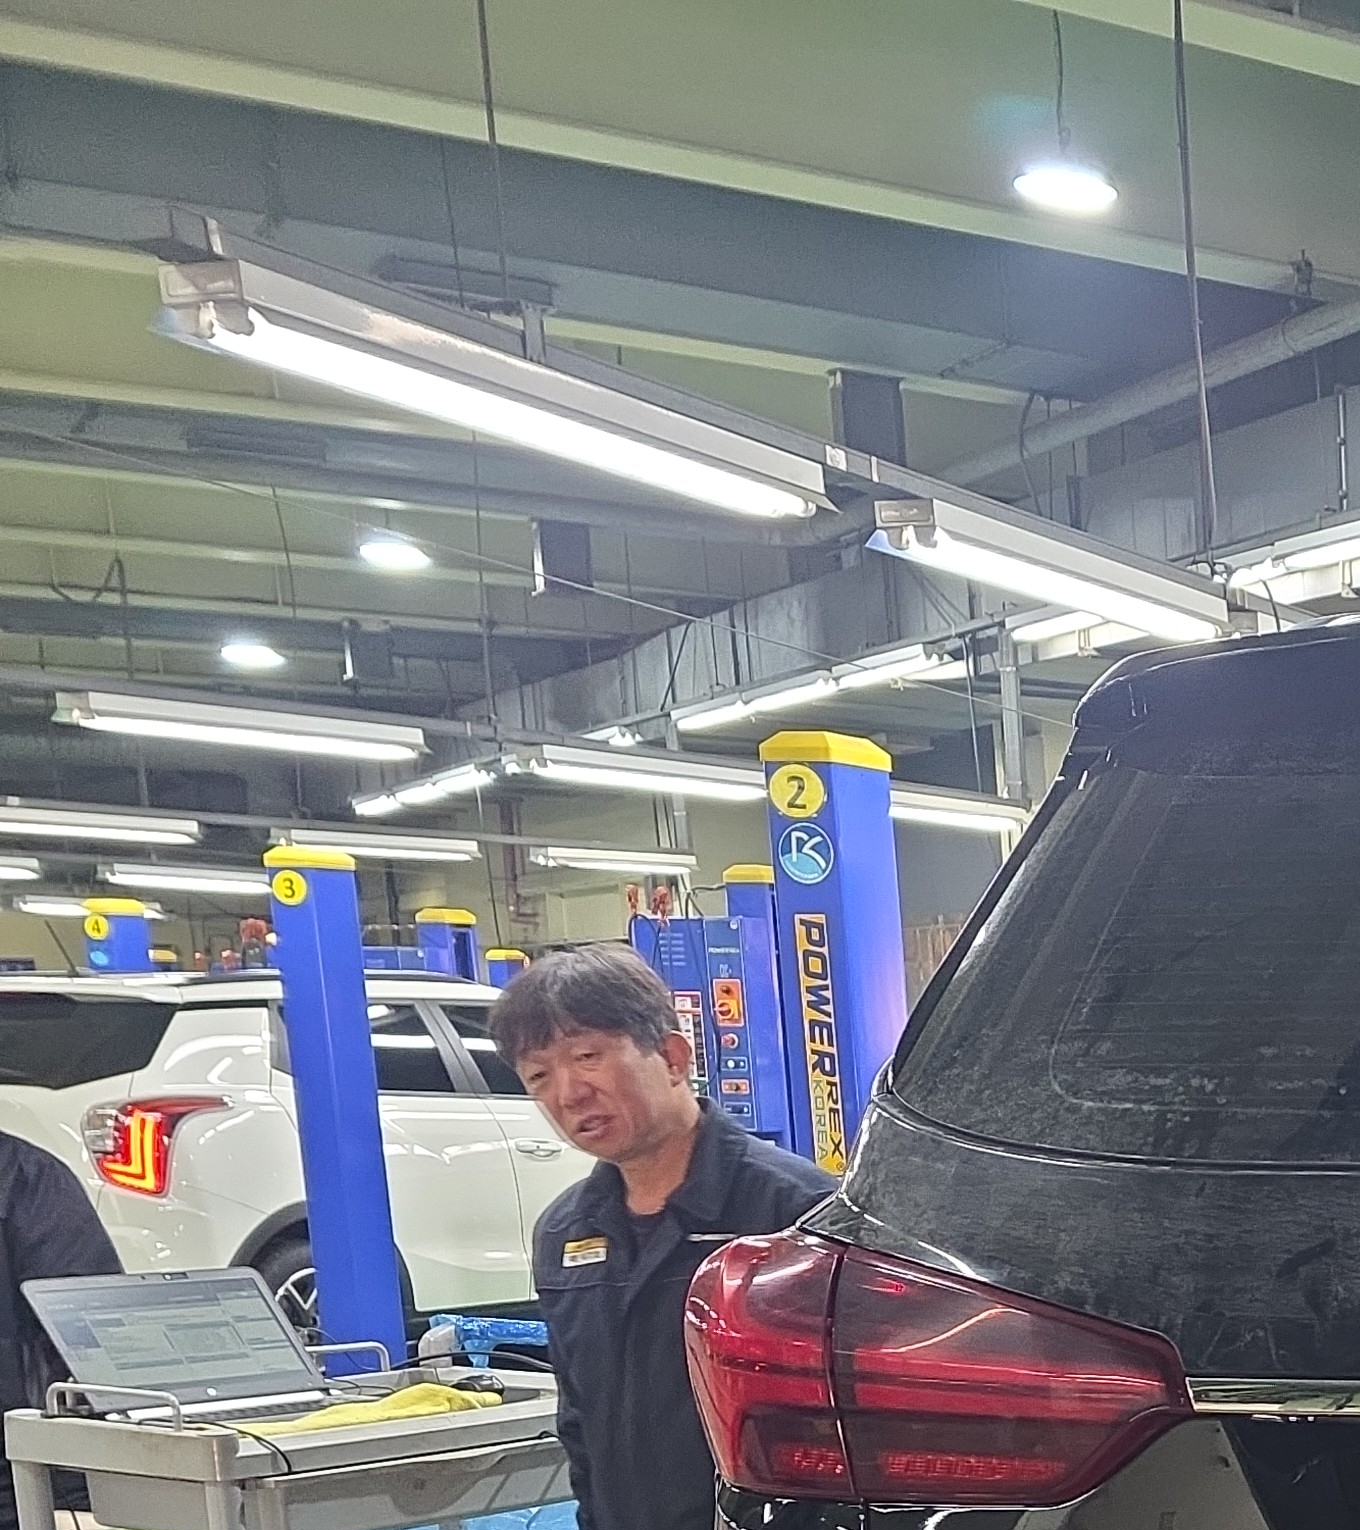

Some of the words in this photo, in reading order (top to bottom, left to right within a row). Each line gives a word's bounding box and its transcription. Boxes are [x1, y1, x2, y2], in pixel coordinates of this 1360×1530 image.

[786, 775, 807, 809] 2
[283, 877, 296, 899] 3
[812, 1079, 829, 1160] KOREA
